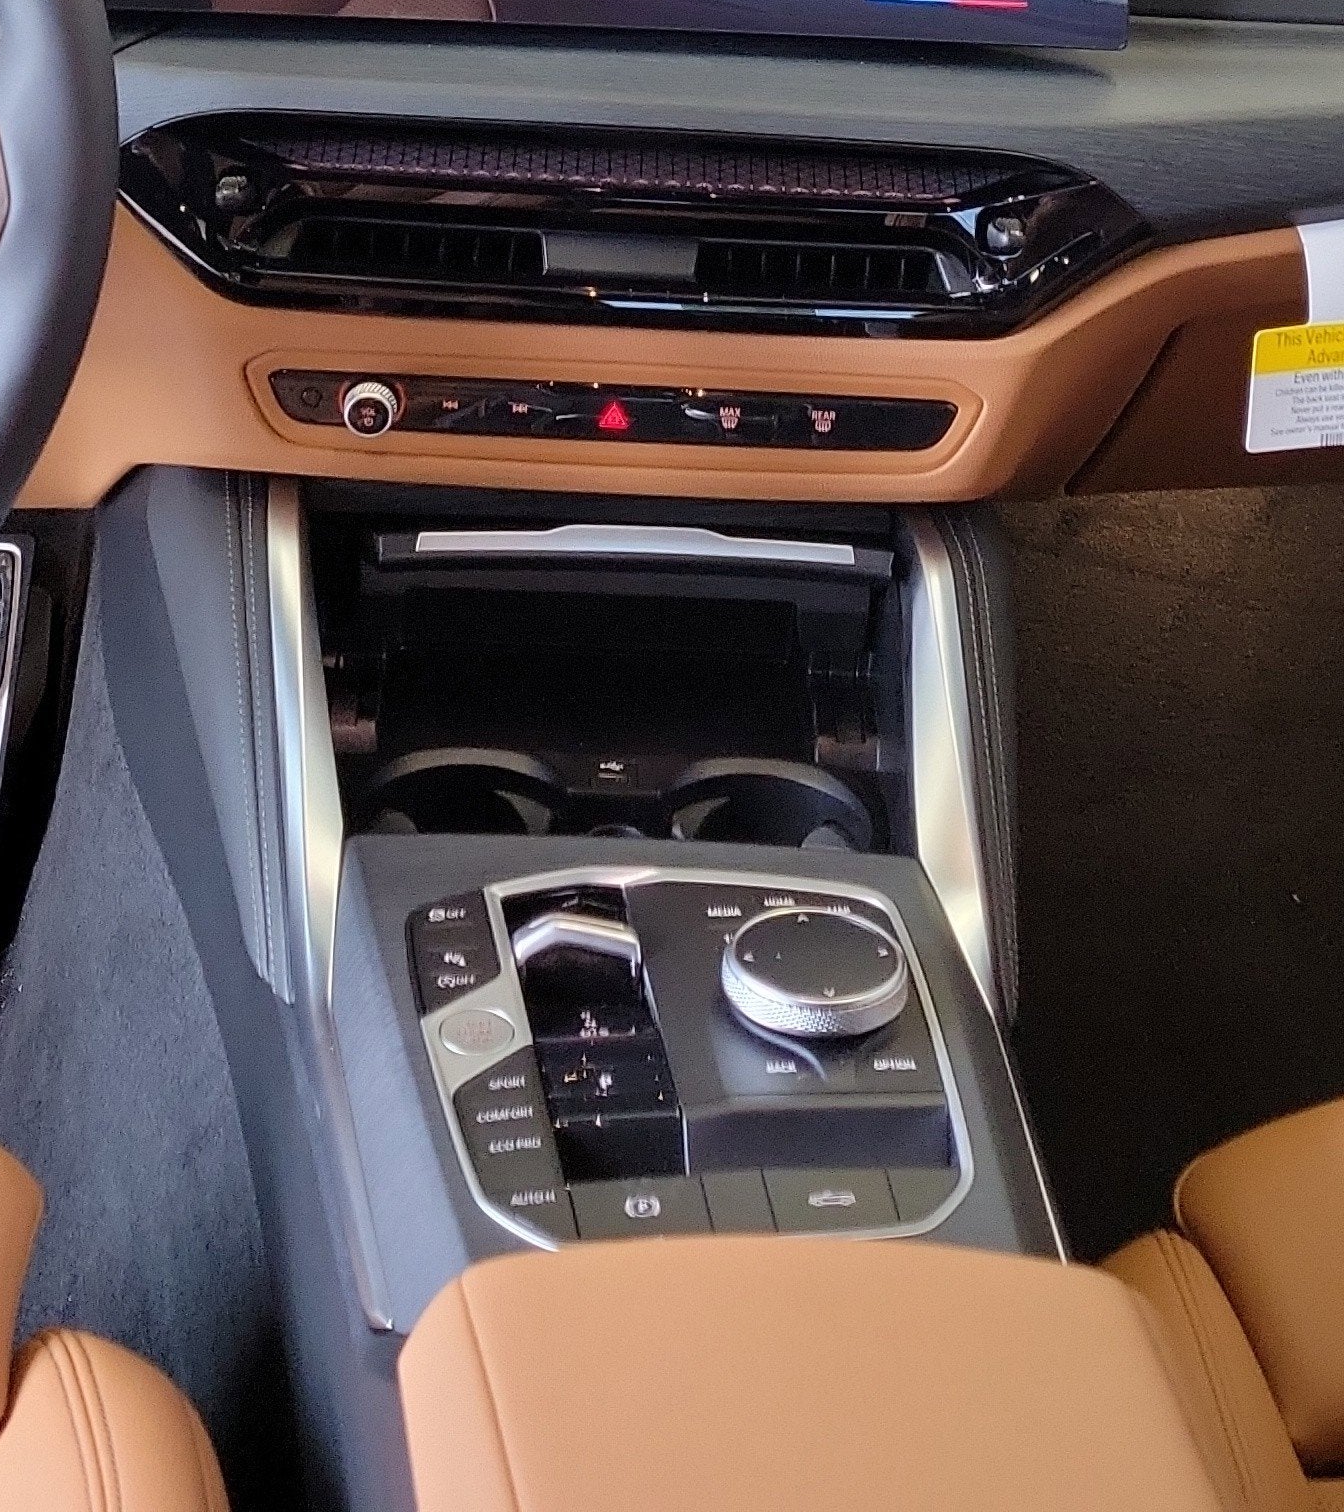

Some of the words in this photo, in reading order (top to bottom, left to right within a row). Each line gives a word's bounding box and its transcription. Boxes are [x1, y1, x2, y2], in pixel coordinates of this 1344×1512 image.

[1275, 332, 1302, 349] This
[1294, 371, 1320, 384] Even
[1322, 369, 1344, 381] with
[719, 406, 741, 418] MAX
[811, 409, 836, 421] REAR
